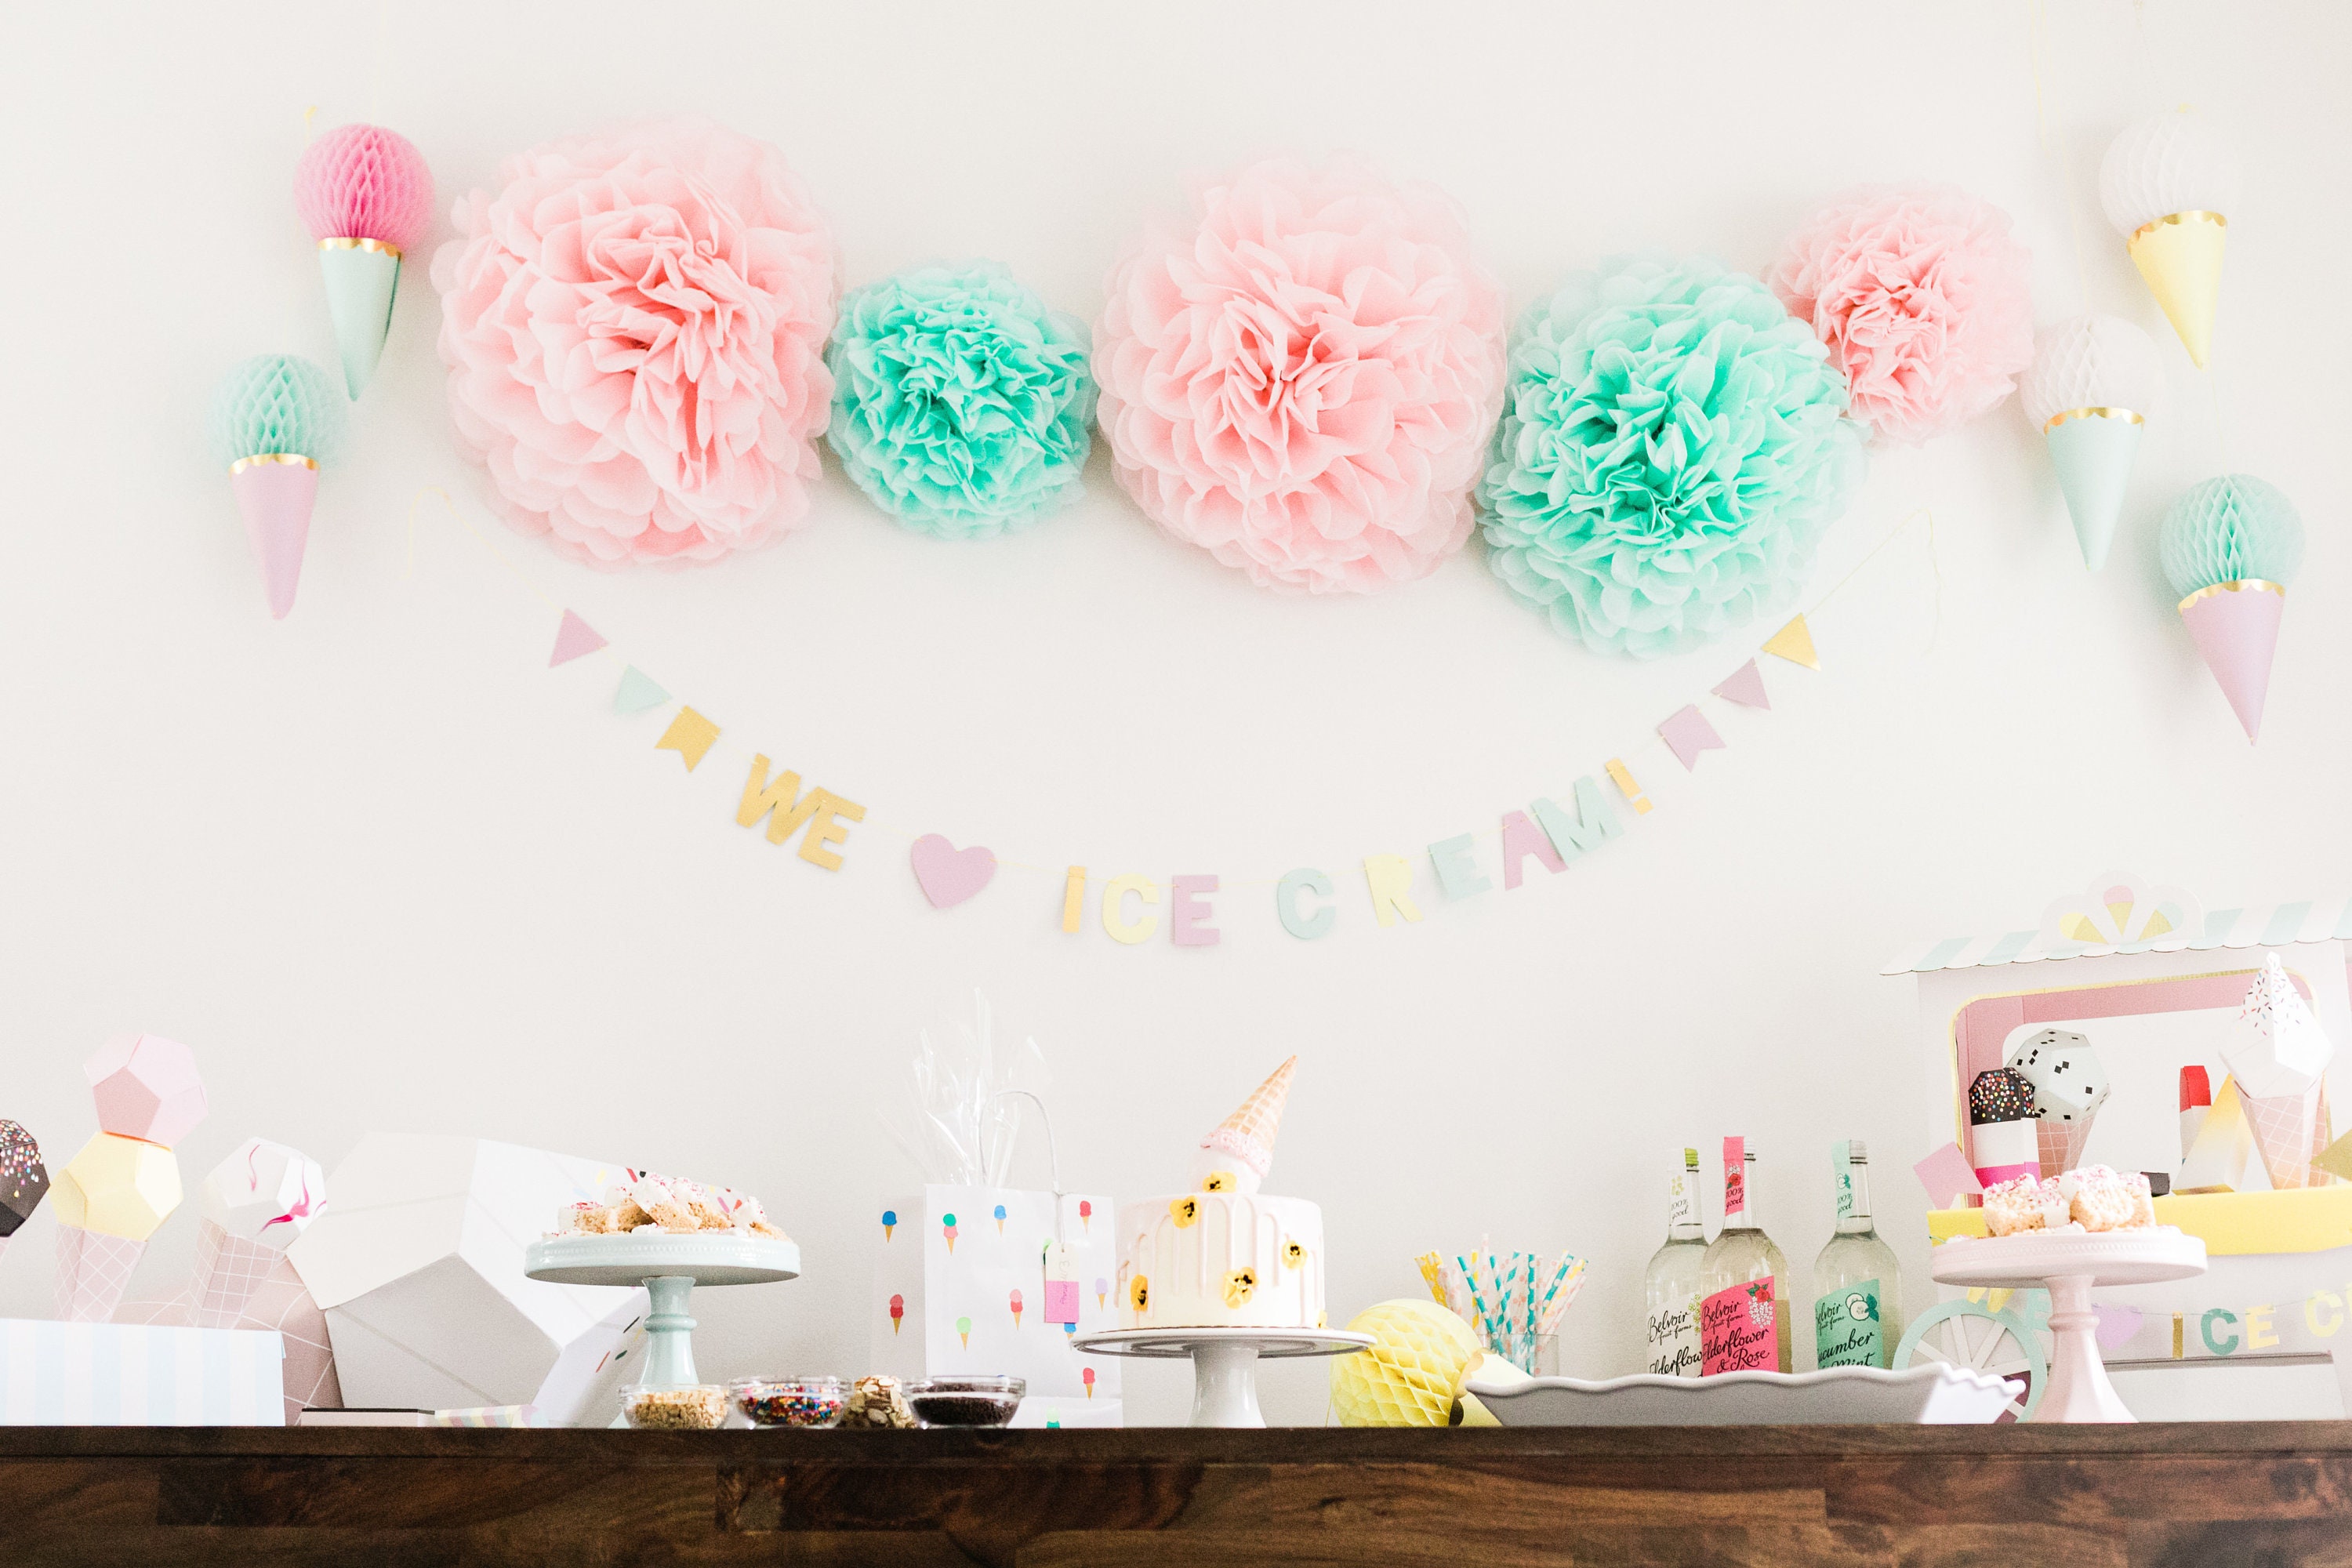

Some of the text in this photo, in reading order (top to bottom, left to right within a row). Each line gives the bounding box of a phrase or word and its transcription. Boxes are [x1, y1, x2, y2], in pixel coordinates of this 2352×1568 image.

[736, 753, 867, 872] WE
[1062, 866, 1221, 946] ICE
[1648, 1310, 1690, 1343] Belvoir
[1701, 1300, 1742, 1332] Belvoir
[1711, 1314, 1745, 1334] fruit farms
[2172, 1307, 2280, 1359] ICE
[2304, 1281, 2352, 1338] C
[1657, 1325, 1692, 1345] fruit farms
[1702, 1327, 1769, 1364] Elderflower
[1817, 1328, 1875, 1364] ucumber
[1717, 1359, 1730, 1374] &
[1730, 1347, 1769, 1371] Rose
